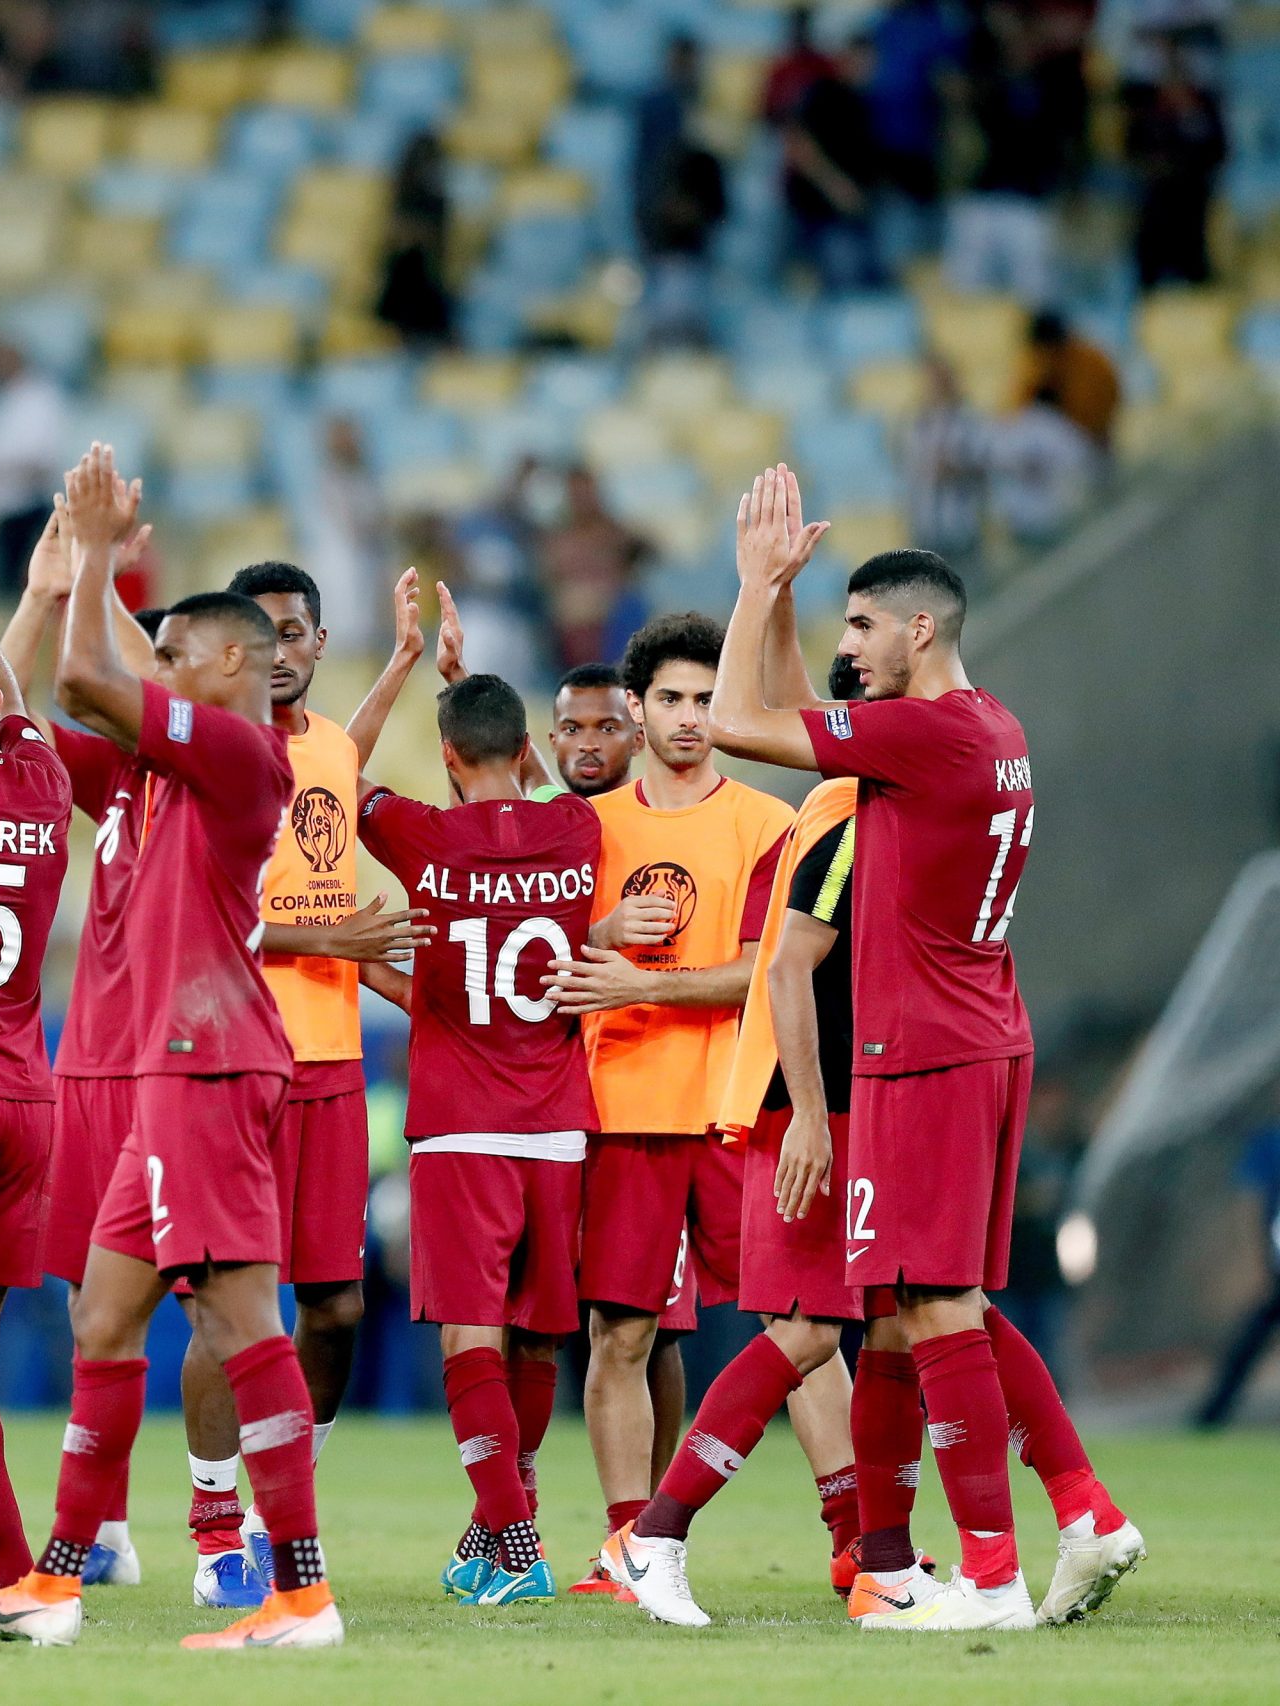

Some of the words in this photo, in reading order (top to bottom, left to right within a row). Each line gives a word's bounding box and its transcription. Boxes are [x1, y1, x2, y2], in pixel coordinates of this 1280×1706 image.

[828, 710, 840, 736] grande
[840, 724, 847, 736] en
[270, 896, 310, 911] COPA
[416, 863, 459, 901] AL
[468, 863, 595, 904] HAYDOS
[448, 916, 573, 1025] 10
[147, 1155, 169, 1223] 2
[846, 1177, 875, 1240] 12
